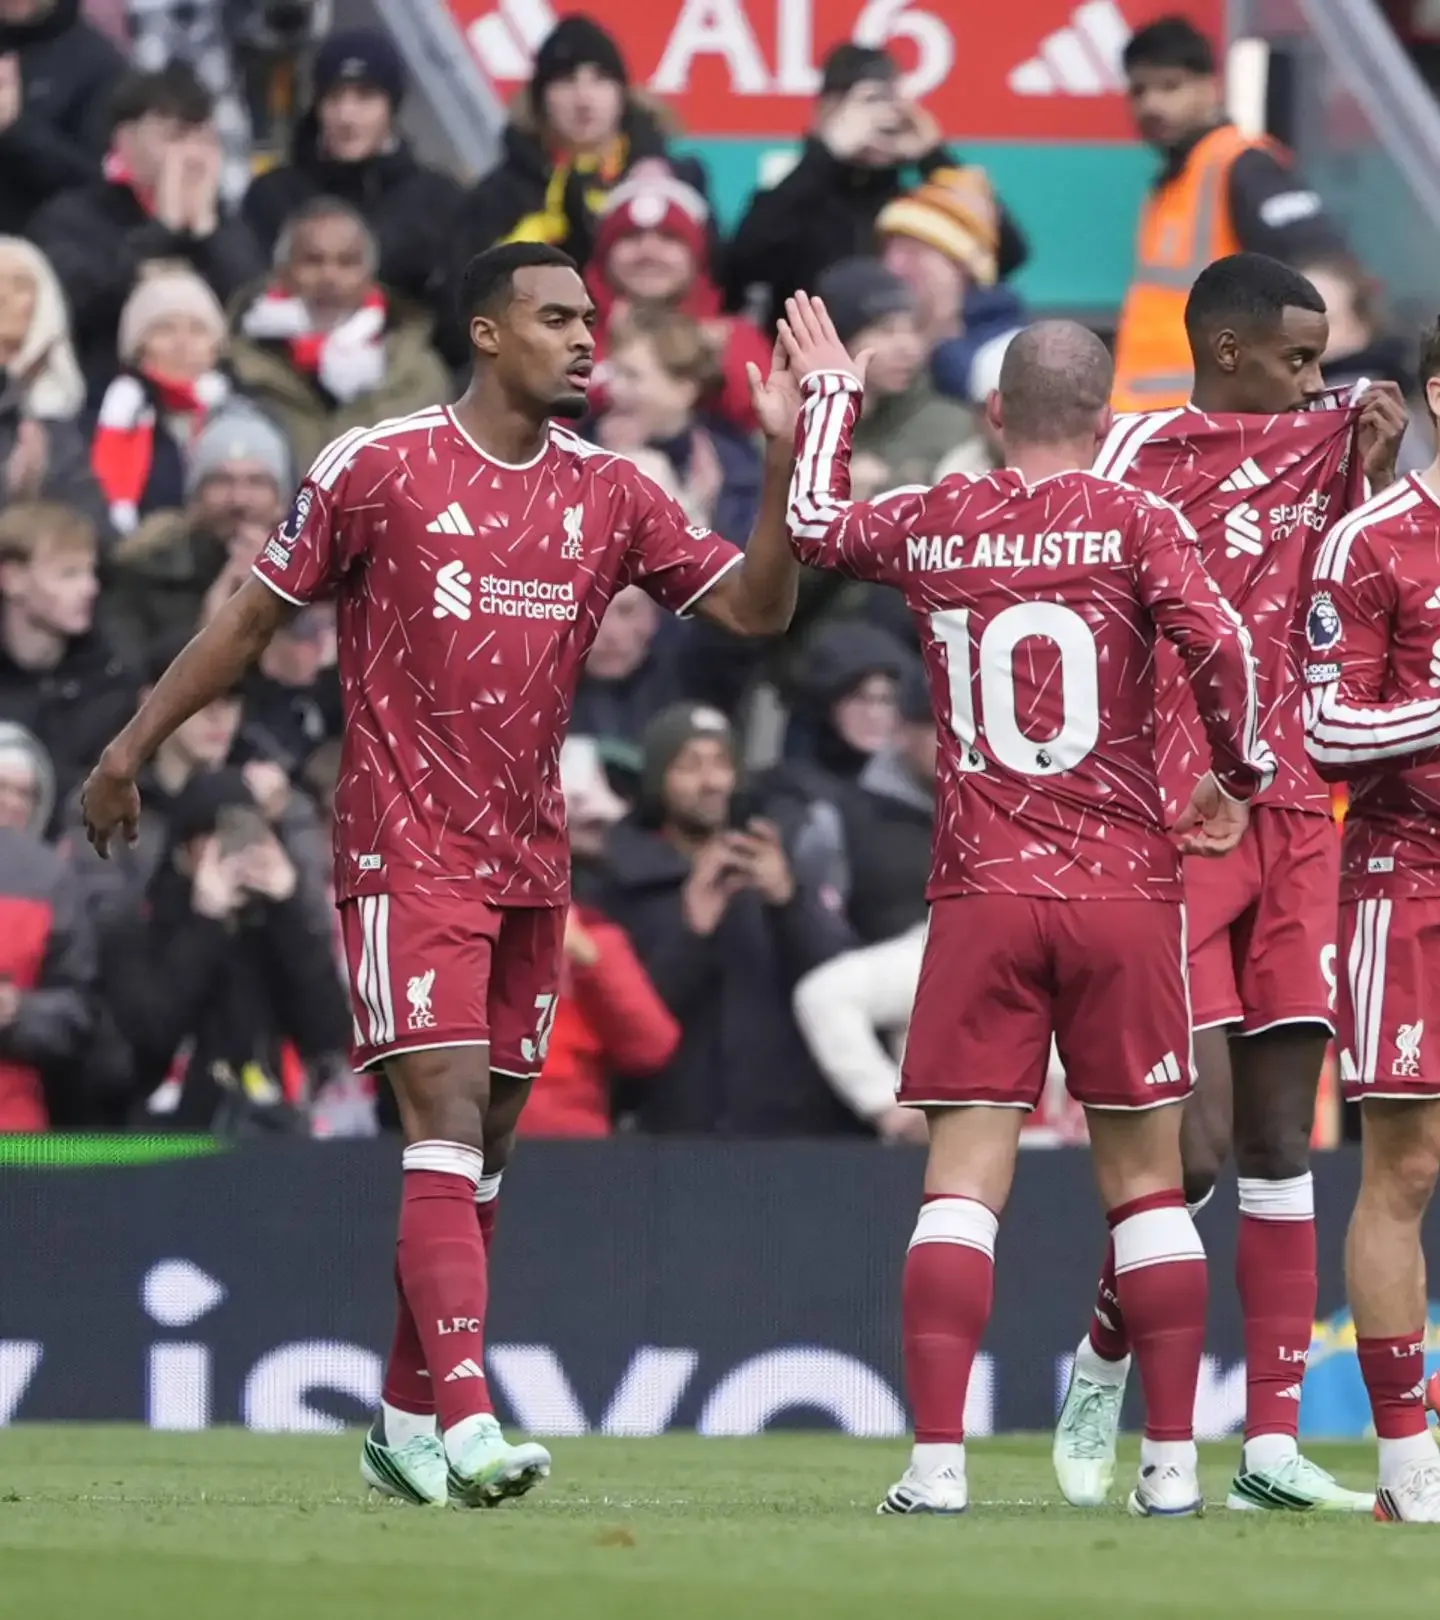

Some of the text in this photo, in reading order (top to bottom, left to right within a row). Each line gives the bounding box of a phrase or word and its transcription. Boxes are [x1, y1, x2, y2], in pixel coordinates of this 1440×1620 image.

[560, 546, 584, 560] LFC
[906, 529, 1122, 571] MAC ALLISTER
[480, 574, 574, 600] standard
[479, 594, 578, 621] chartered
[930, 600, 1100, 776] 10
[407, 1014, 438, 1030] LFC
[1391, 1057, 1421, 1077] LFC
[437, 1316, 480, 1336] LFC
